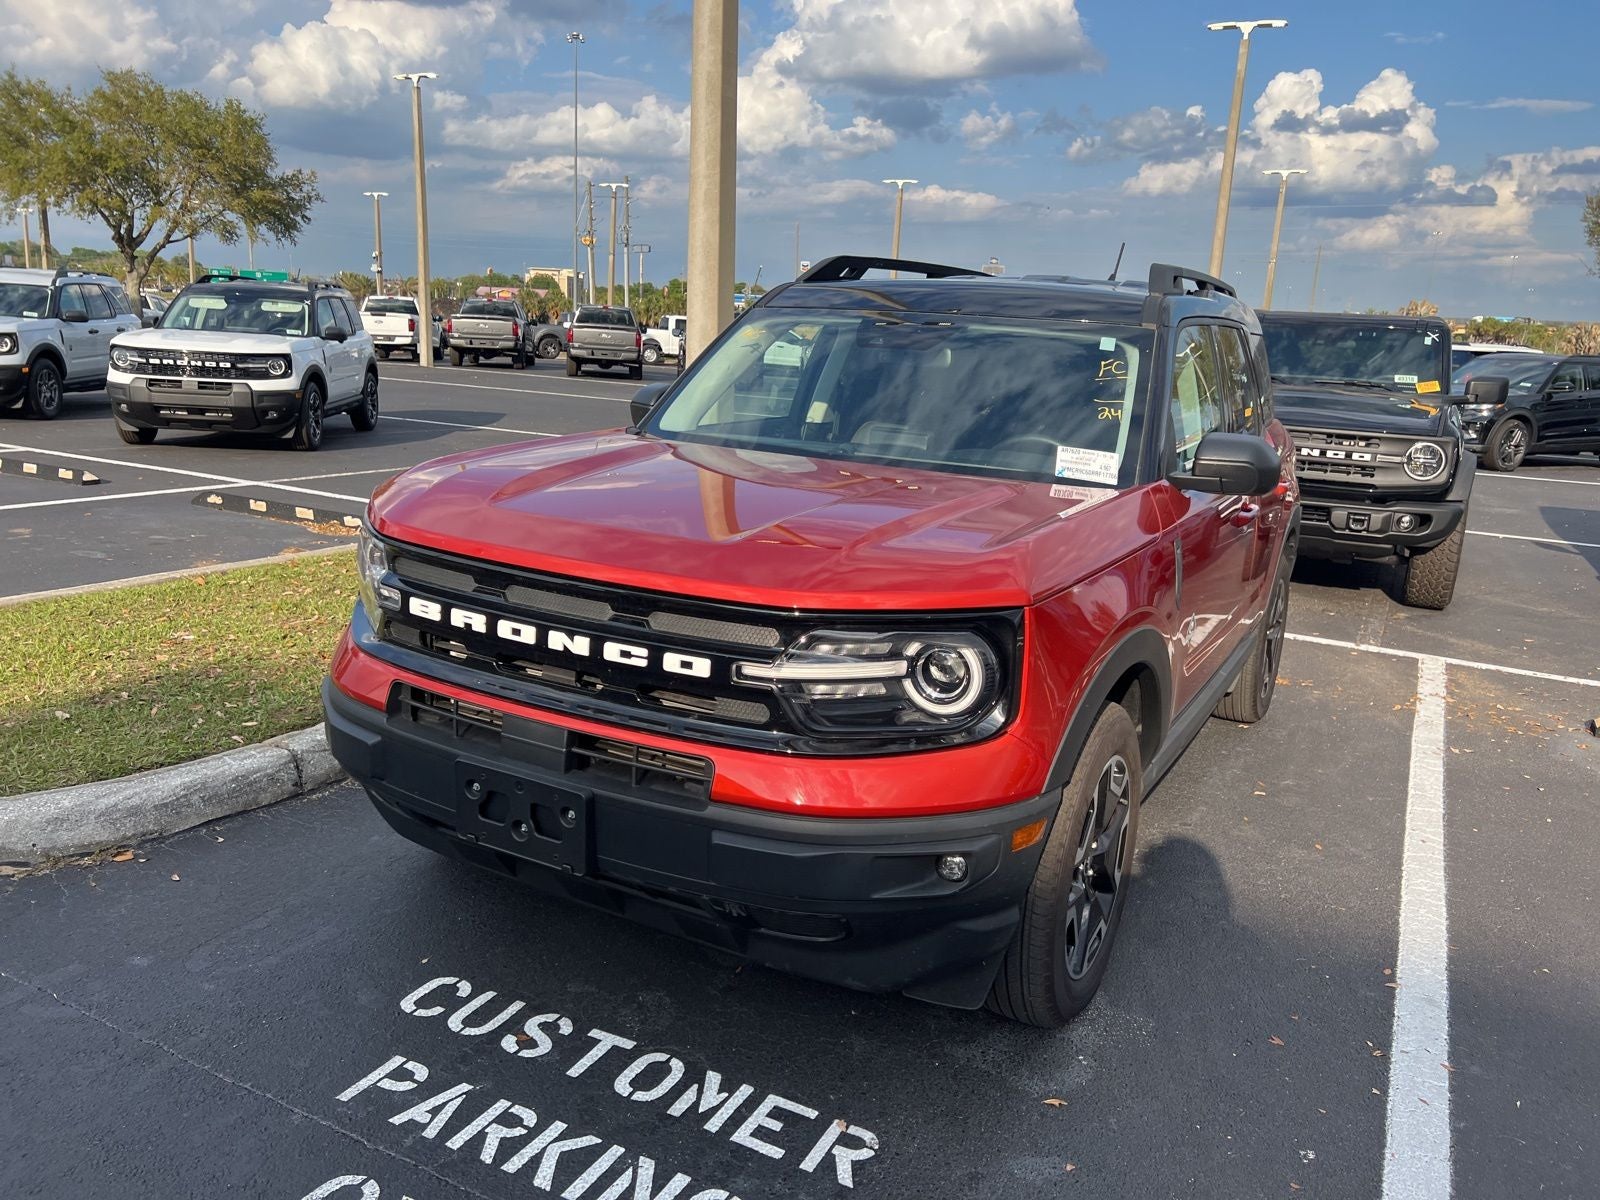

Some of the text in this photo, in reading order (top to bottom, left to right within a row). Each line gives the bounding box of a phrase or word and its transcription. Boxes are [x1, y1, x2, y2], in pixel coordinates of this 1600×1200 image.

[148, 358, 231, 368] BRONCO
[1099, 359, 1125, 377] FC
[1098, 407, 1121, 420] 24
[408, 596, 712, 678] BRONCO
[399, 976, 879, 1188] CUSTOMER
[335, 1055, 741, 1200] PARKIN
